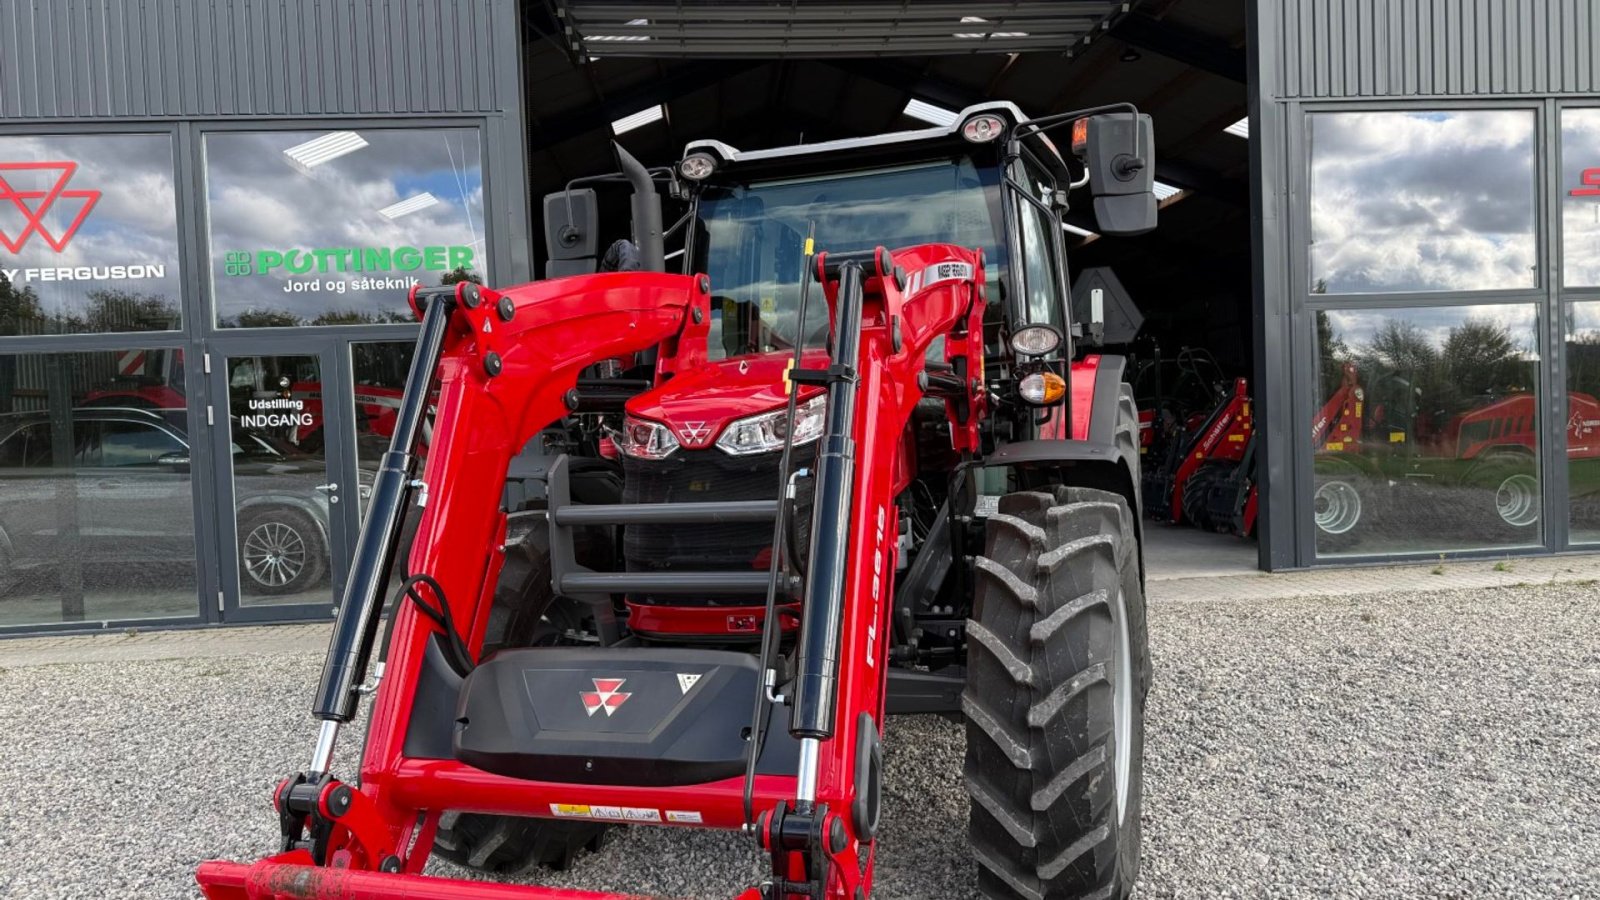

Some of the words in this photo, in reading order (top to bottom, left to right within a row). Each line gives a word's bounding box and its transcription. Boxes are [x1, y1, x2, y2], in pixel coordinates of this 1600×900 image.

[25, 264, 165, 282] FERGUSON
[283, 279, 321, 293] Jord
[325, 280, 346, 293] og
[351, 276, 420, 290] såteknik
[248, 399, 304, 410] Udstilling
[240, 413, 314, 428] INDGANG
